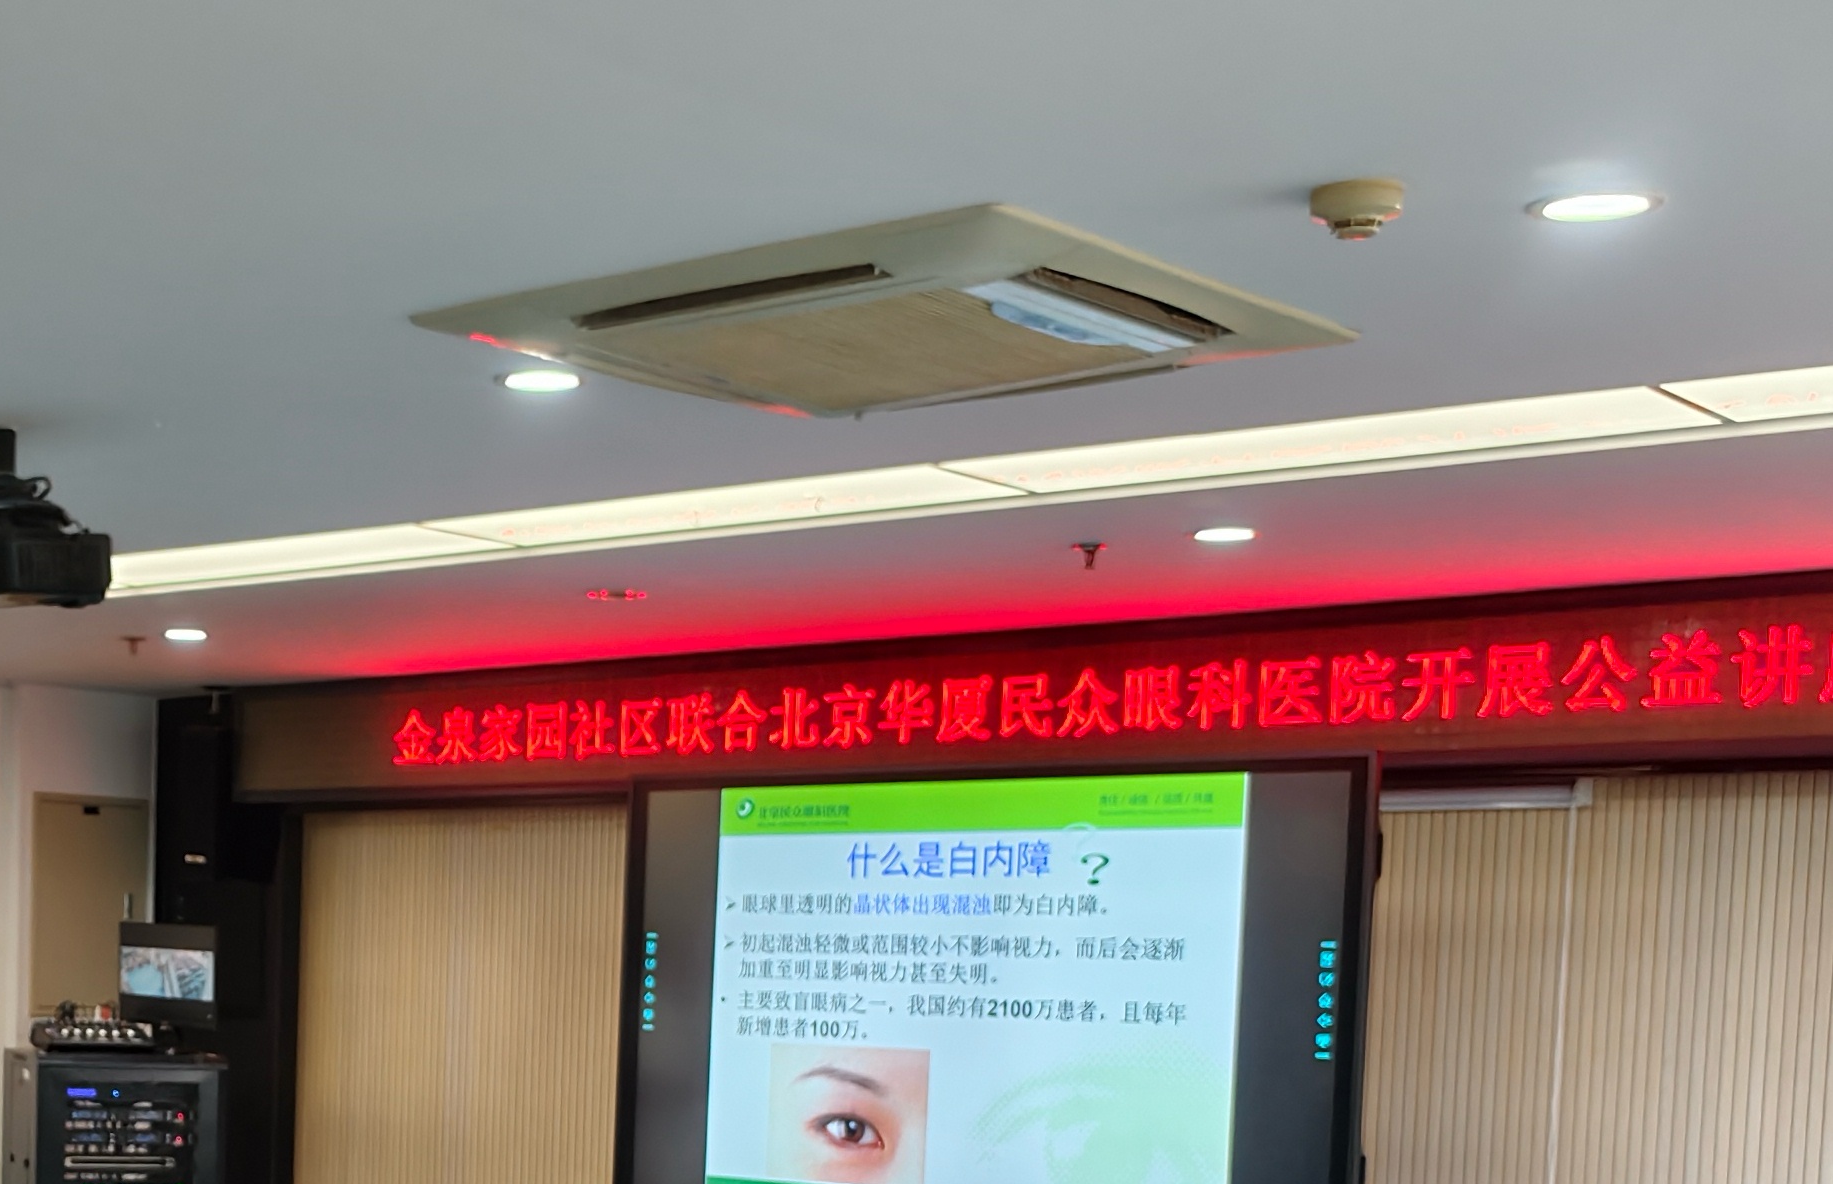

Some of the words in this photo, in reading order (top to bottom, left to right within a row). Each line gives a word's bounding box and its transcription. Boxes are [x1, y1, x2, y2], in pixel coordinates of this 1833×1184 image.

[392, 622, 1833, 765] 金泉家园社区联合北京华厦民众眼科医院开展公益讲
[847, 839, 1051, 879] 什么是白内障
